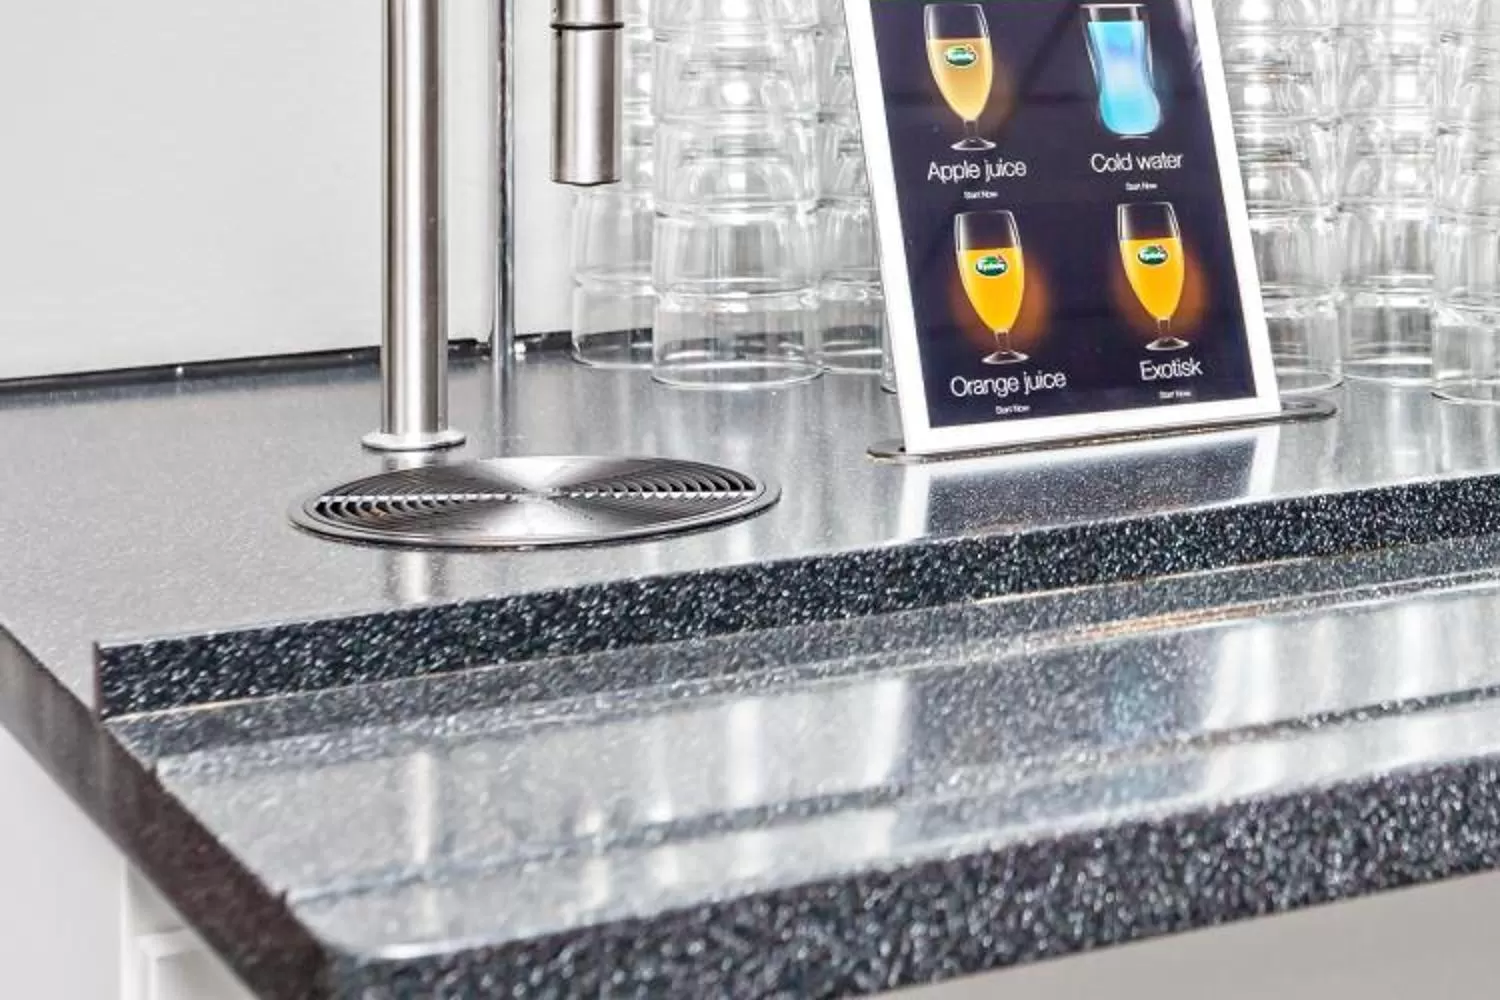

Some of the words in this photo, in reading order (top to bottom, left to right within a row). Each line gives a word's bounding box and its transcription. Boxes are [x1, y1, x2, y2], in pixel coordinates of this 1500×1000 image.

[927, 160, 980, 185] Apple
[983, 157, 1028, 183] juice
[1091, 152, 1133, 173] Cold
[1135, 151, 1184, 171] water
[1139, 357, 1204, 381] Exotisk
[950, 375, 1020, 398] Orange
[1023, 370, 1067, 396] juice
